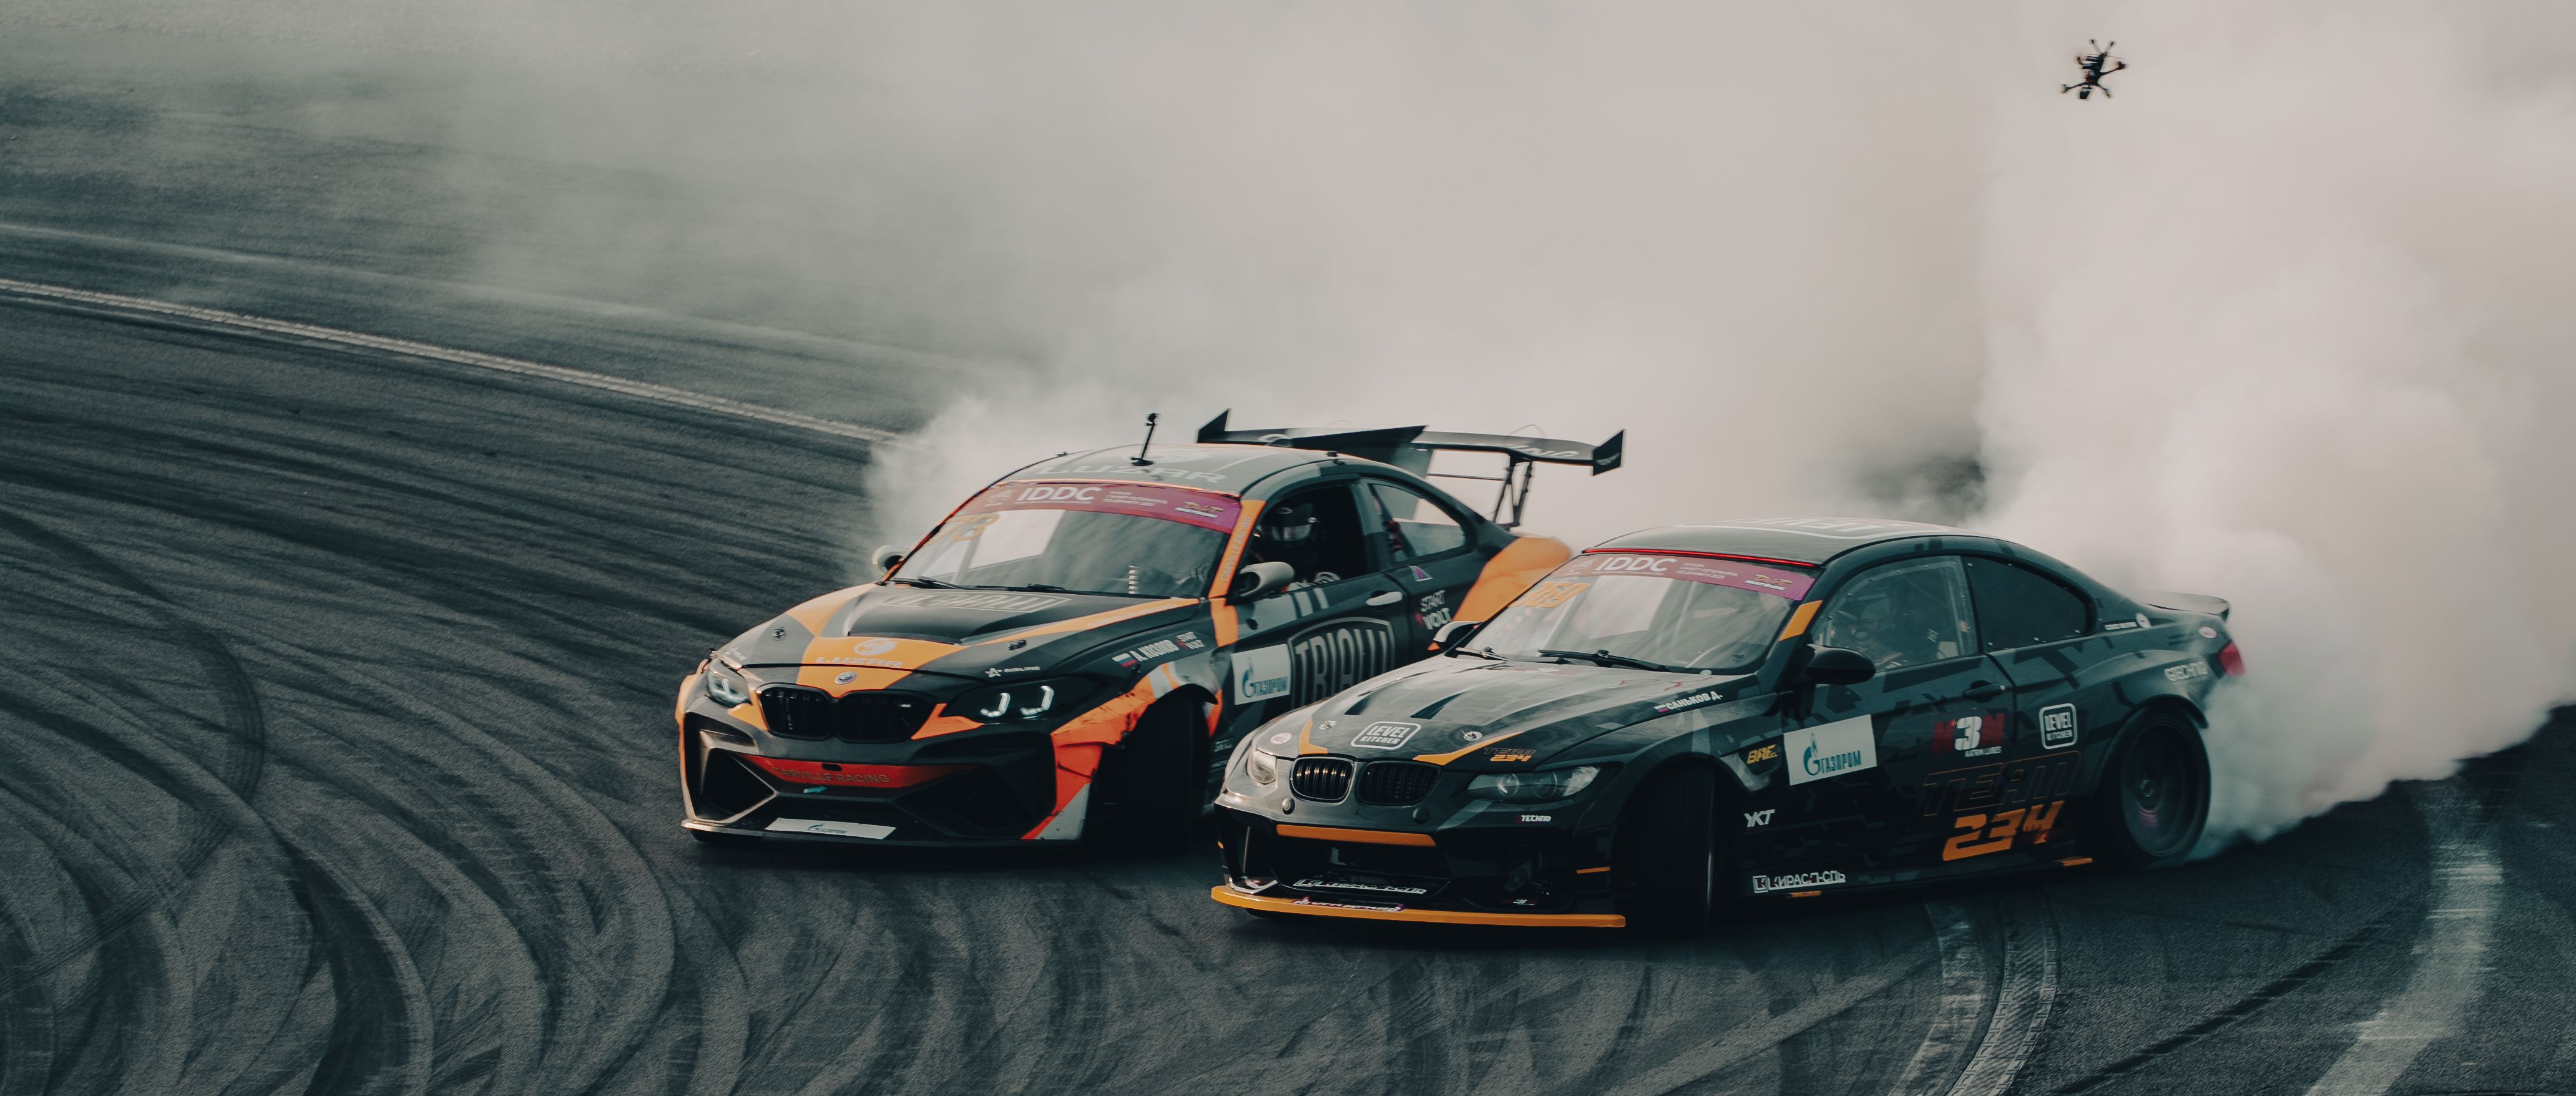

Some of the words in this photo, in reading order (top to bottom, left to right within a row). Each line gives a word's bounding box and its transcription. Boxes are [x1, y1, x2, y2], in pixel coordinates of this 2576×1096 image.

[1036, 465, 1228, 484] LUZAR
[1017, 486, 1104, 501] IDDC
[1595, 557, 1678, 573] IDDC
[1422, 607, 1452, 630] VOLT
[815, 657, 904, 668] LUZAR
[1665, 693, 1711, 710] САНЬКОВ
[2044, 712, 2072, 731] LEVEL
[1366, 725, 1411, 738] LEVEL
[1359, 736, 1401, 745] KITCHEN
[1821, 750, 1863, 774] ГАЗПРОМ
[771, 766, 833, 781] CARVILLE
[836, 773, 891, 783] RACING
[1941, 800, 2066, 862] 234
